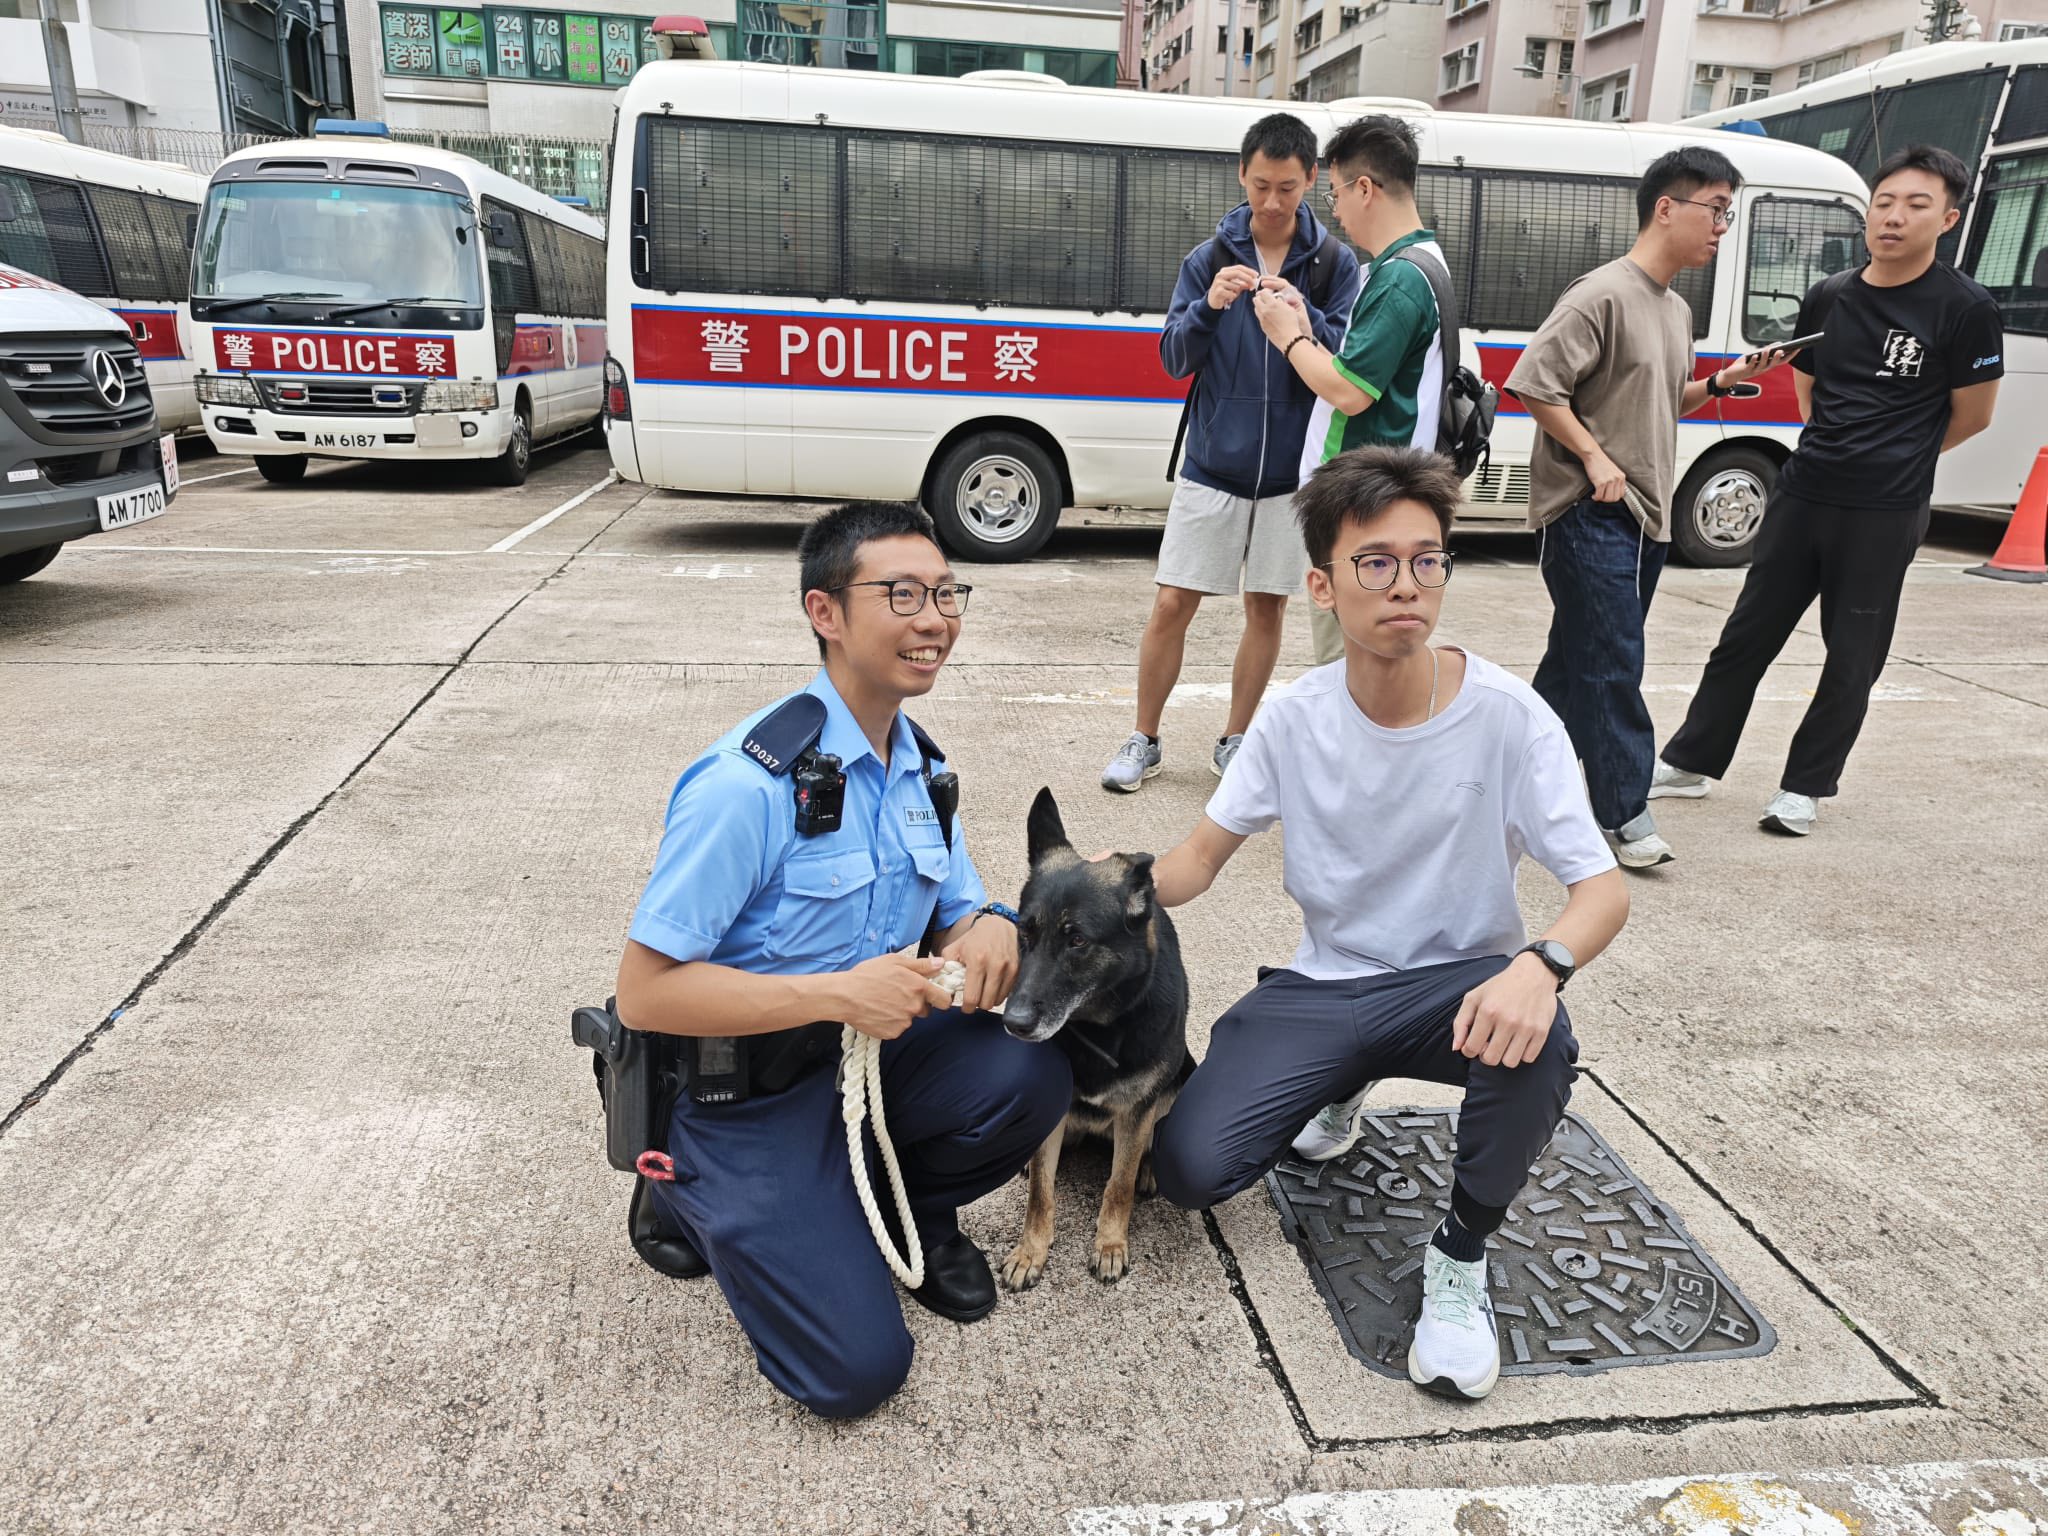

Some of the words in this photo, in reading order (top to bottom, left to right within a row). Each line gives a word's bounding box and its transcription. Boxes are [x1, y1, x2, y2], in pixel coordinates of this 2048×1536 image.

[385, 11, 430, 39] 資深
[496, 15, 523, 34] 24
[533, 18, 560, 36] 78
[607, 23, 630, 41] 91
[388, 42, 432, 70] 老師
[499, 40, 525, 69] 中
[536, 42, 562, 72] 小
[607, 48, 633, 77] 幼
[223, 334, 255, 367] 警
[271, 337, 400, 373] POLICE
[415, 341, 447, 374] 察
[701, 319, 750, 373] 警
[779, 324, 968, 382] POLICE
[994, 330, 1039, 383] 察
[314, 434, 335, 447] AM
[340, 434, 376, 447] 6187
[108, 498, 129, 525] AM
[130, 490, 162, 518] 7700
[745, 740, 780, 768] 19037
